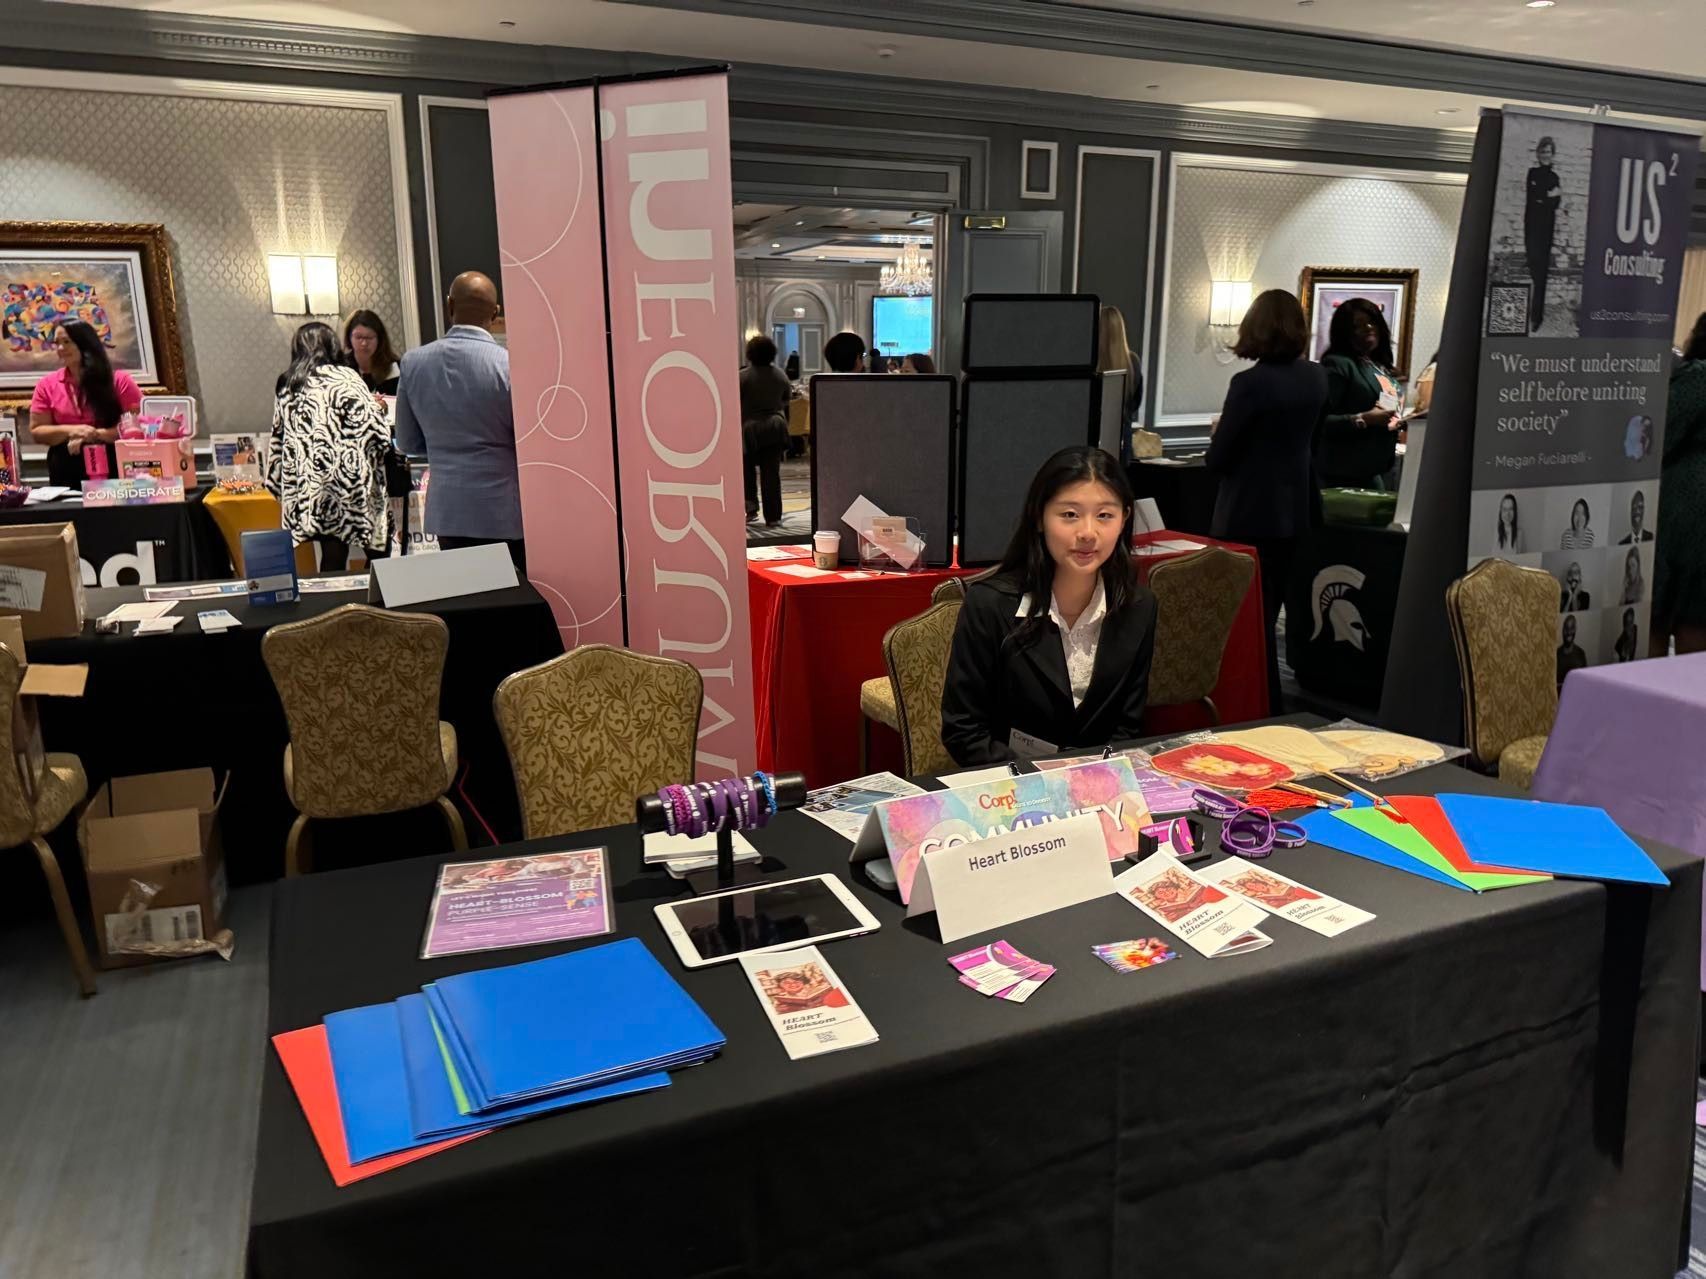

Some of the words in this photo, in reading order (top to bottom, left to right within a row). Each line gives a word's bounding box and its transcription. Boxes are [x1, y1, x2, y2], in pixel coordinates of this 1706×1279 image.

[1604, 248, 1666, 285] Consulting
[1535, 357, 1576, 373] must
[1581, 352, 1661, 373] understand
[1499, 381, 1535, 402] self
[1537, 381, 1589, 402] before
[1592, 381, 1647, 405] uniting
[1495, 455, 1535, 470] Megan
[86, 487, 181, 500] CONSIDERATE
[979, 788, 1018, 810] Corp!
[968, 847, 1007, 871] Heart
[1010, 836, 1066, 860] Blossom
[1179, 909, 1211, 932] HEART
[1287, 903, 1312, 917] HEART
[1295, 905, 1327, 920] Blossom
[1185, 909, 1225, 935] Blossom
[782, 1012, 823, 1025] HEART
[785, 1017, 837, 1031] Blossom
